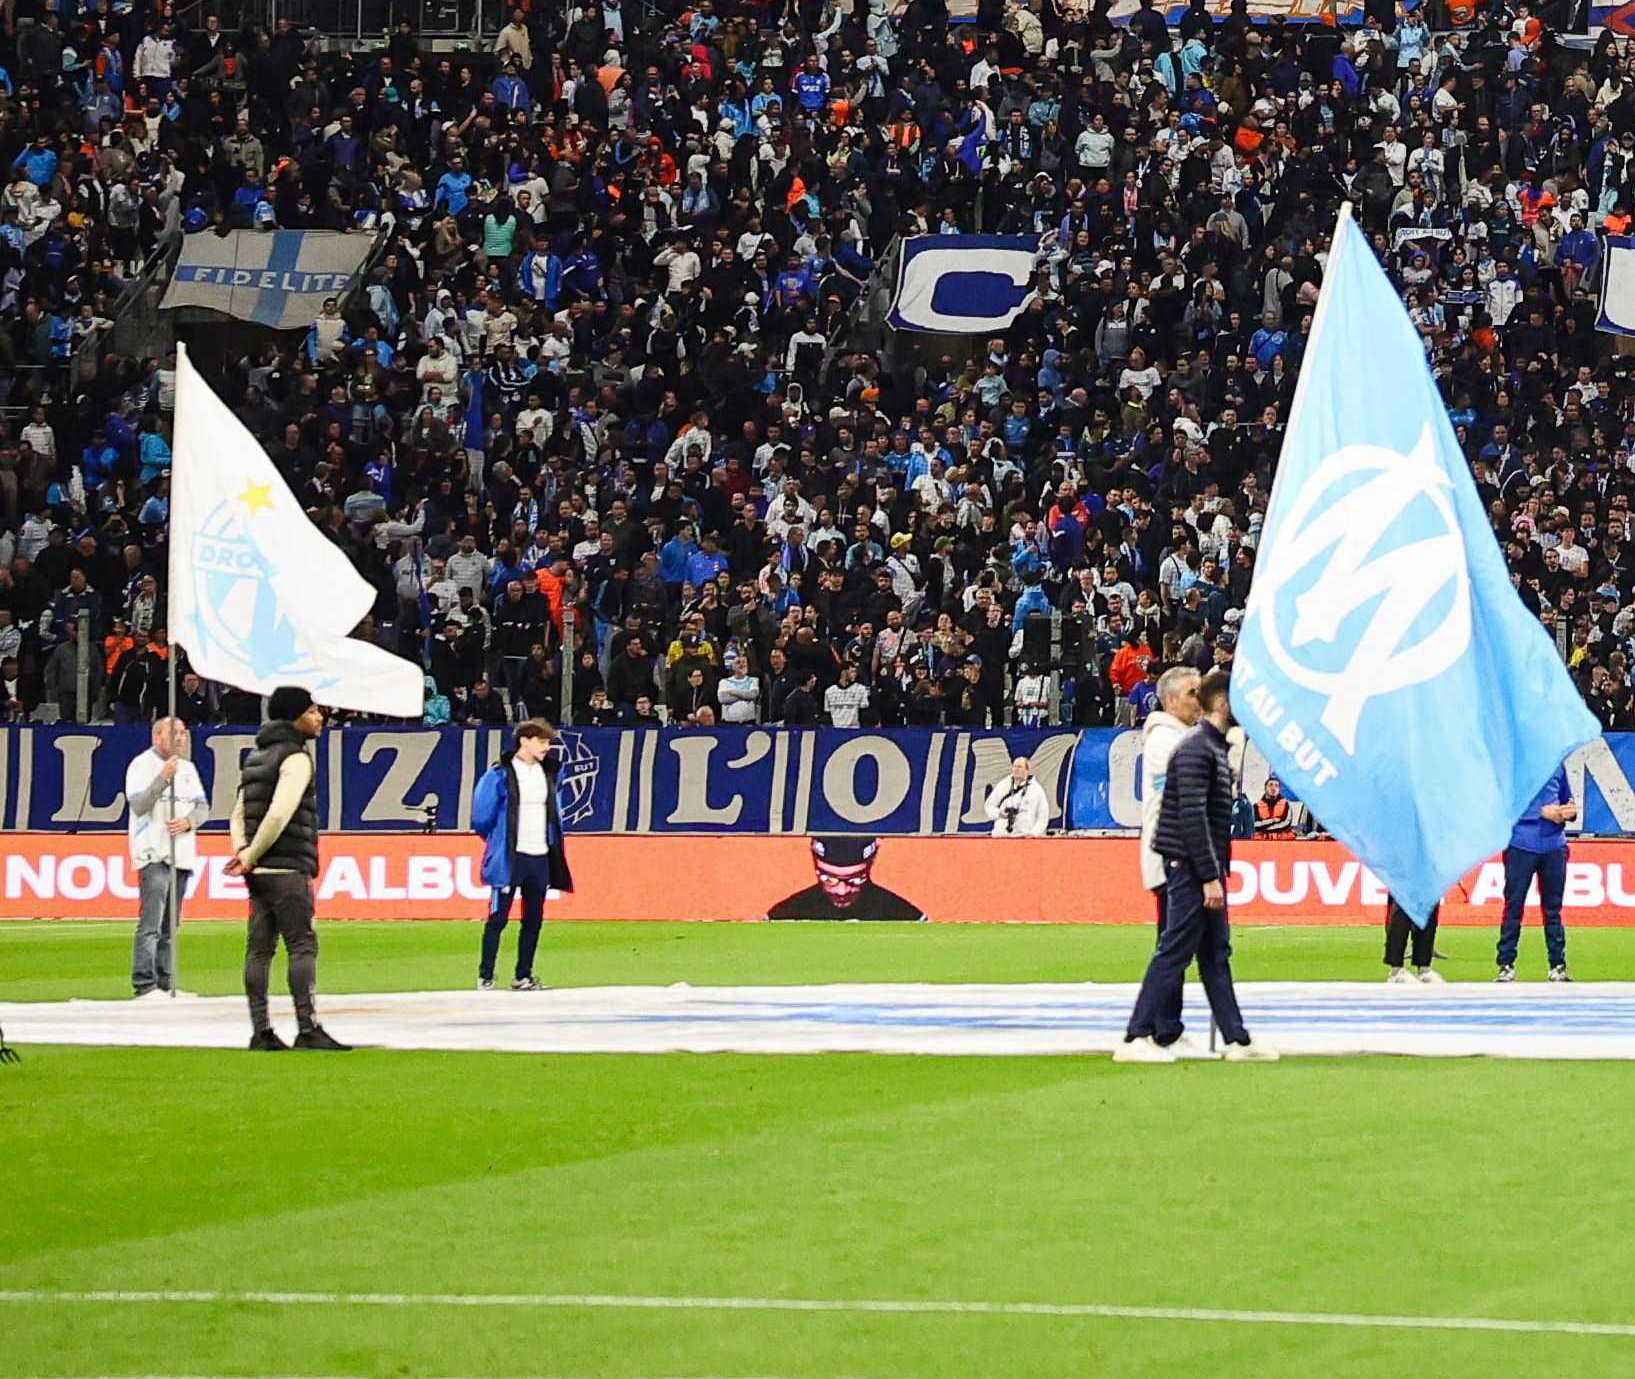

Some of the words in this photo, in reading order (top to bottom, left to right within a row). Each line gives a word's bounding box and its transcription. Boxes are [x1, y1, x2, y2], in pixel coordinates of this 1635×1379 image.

[894, 250, 1040, 332] C
[1244, 683, 1286, 728] AU
[1275, 720, 1341, 788] BUT
[5, 856, 247, 900] NOUE
[316, 856, 561, 900] ALBU
